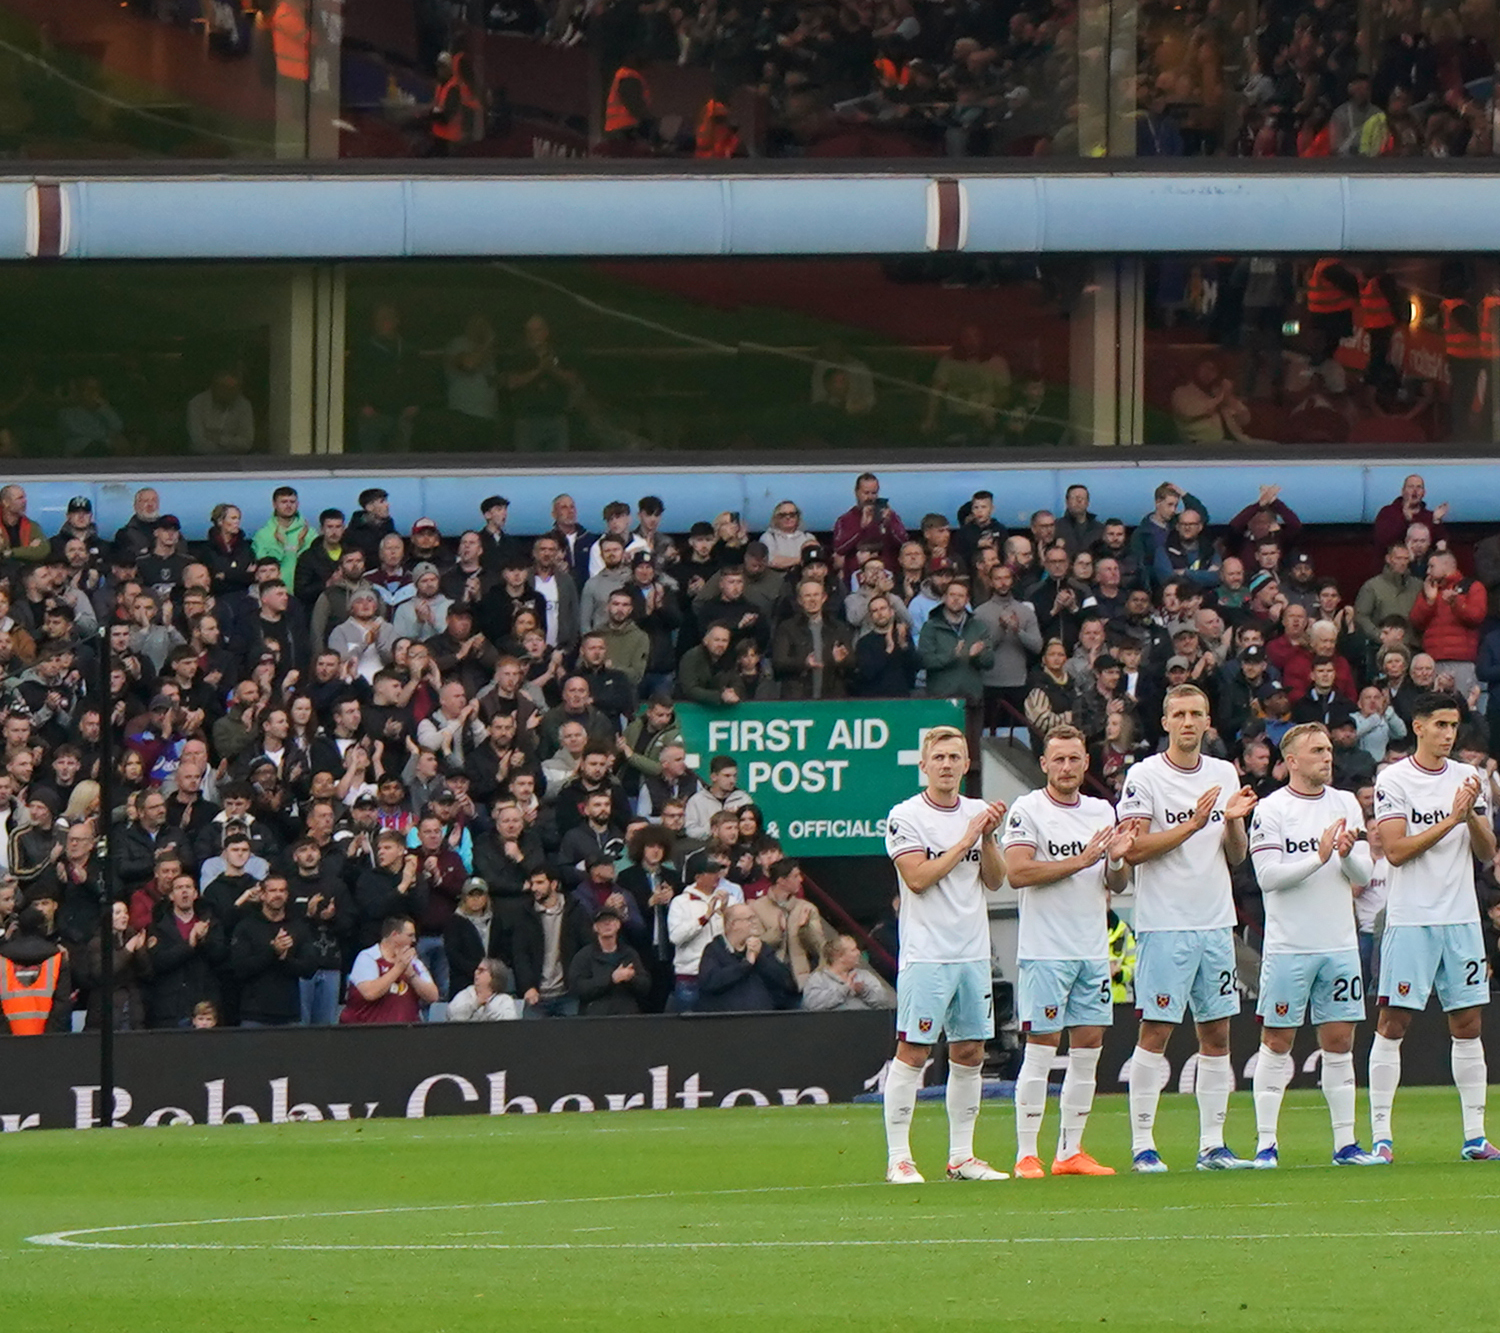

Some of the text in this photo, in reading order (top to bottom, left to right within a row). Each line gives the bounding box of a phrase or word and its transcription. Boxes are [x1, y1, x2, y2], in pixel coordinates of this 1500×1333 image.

[708, 718, 889, 752] FIRST AID
[749, 760, 849, 793] POST
[1165, 808, 1226, 824] beta
[1411, 809, 1454, 825] bet
[766, 819, 888, 839] & OFFICIALS
[926, 847, 983, 865] bewa
[1285, 838, 1339, 855] bet
[1465, 958, 1489, 986] 27
[1100, 979, 1111, 1004] 5
[1333, 976, 1363, 1002] 20
